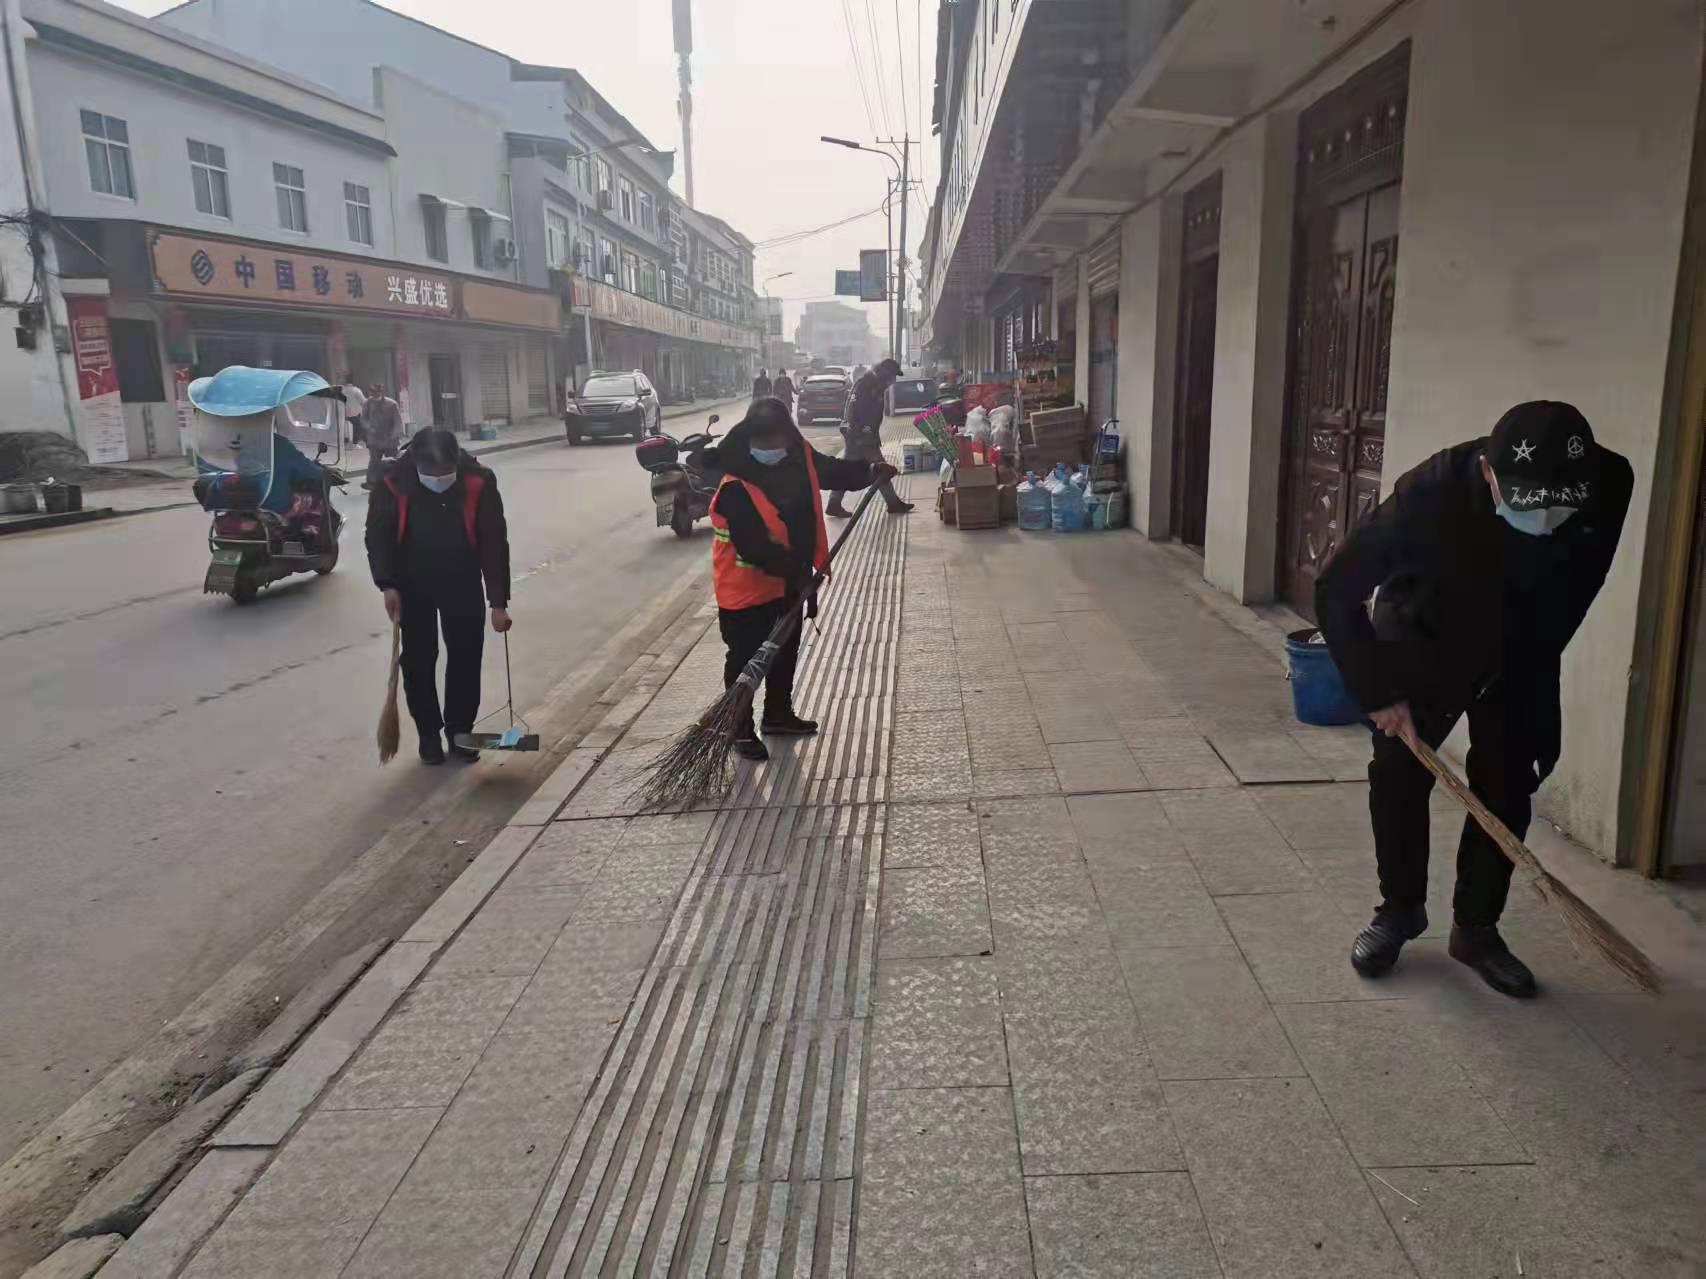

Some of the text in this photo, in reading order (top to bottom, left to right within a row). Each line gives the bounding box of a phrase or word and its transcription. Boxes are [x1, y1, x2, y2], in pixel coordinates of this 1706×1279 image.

[235, 255, 364, 299] 中国移动
[386, 275, 449, 309] 兴盛优选
